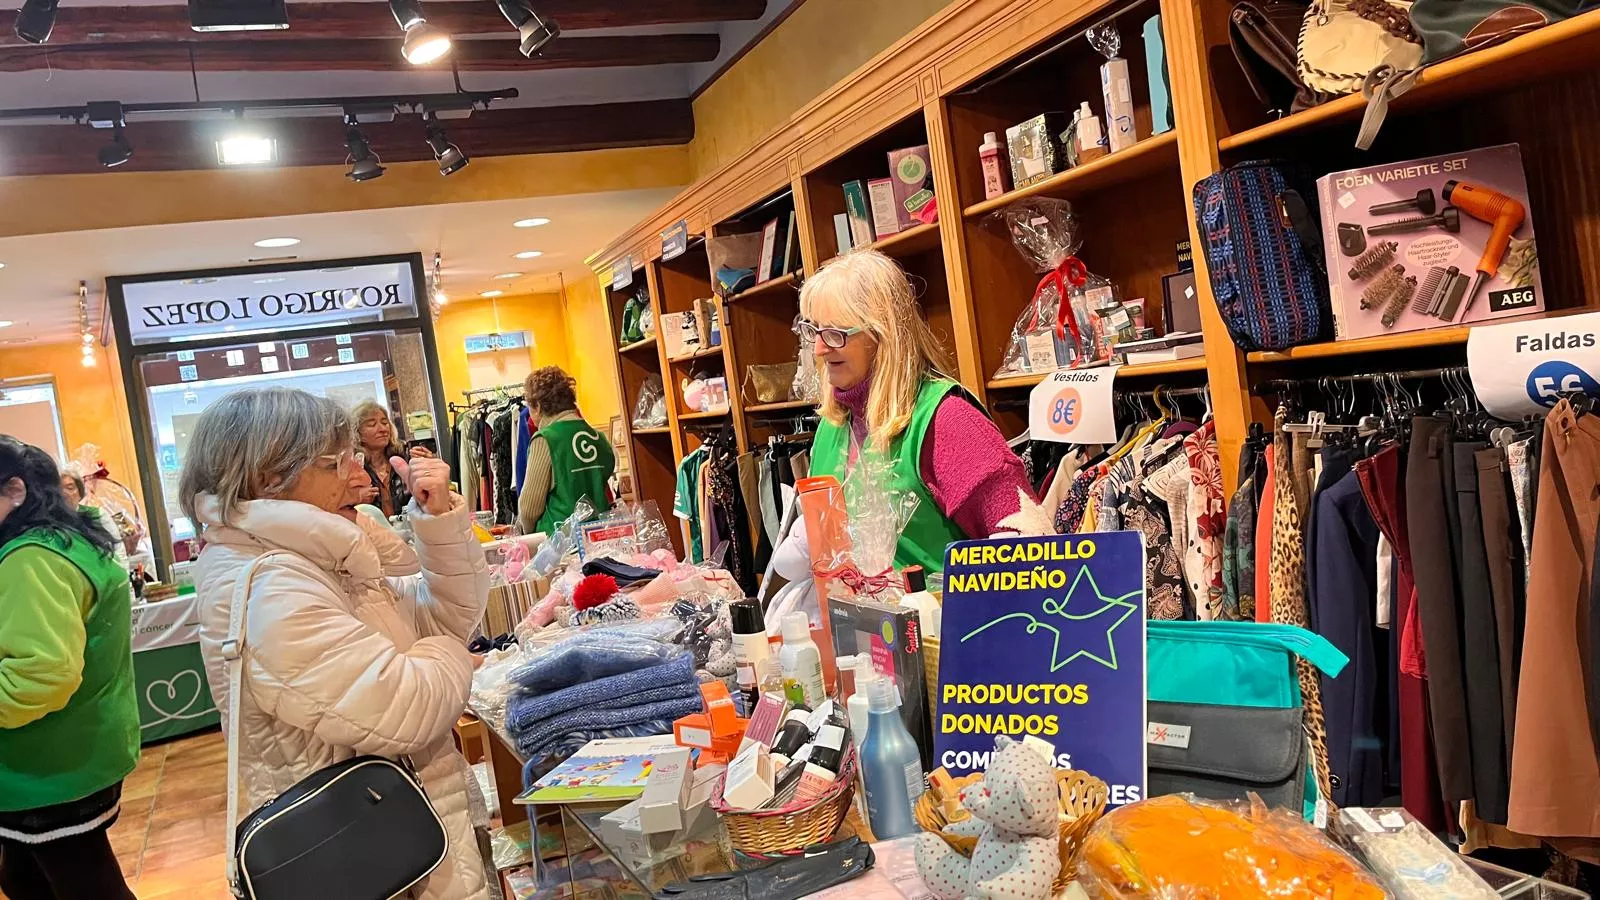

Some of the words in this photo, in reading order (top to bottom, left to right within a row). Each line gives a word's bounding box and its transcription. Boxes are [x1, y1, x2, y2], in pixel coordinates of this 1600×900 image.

[1336, 174, 1374, 190] FOEN
[1376, 162, 1440, 183] VARIETTE
[1442, 158, 1468, 172] SET
[1500, 291, 1534, 306] AEG
[1516, 331, 1596, 353] Faldas
[1053, 372, 1100, 383] Vestidos
[1052, 398, 1077, 425] 8€
[949, 539, 1097, 566] MERCADILLO
[948, 566, 1067, 593] NAVIDEÑO
[942, 683, 1089, 705] PRODUCTOS
[940, 713, 1060, 735] DONADOS
